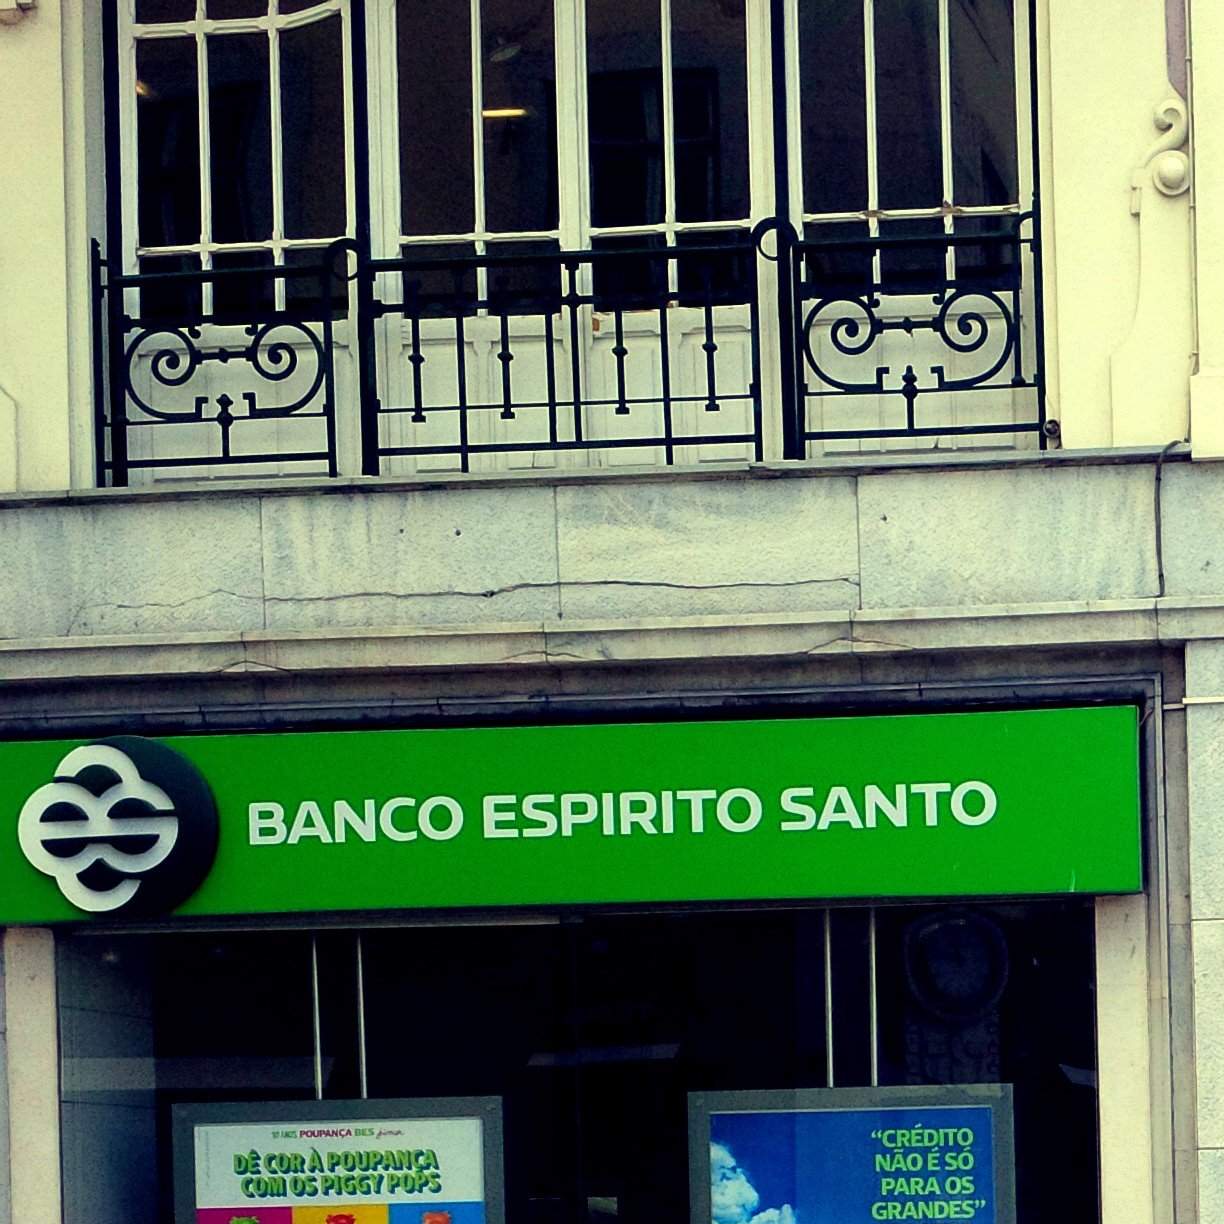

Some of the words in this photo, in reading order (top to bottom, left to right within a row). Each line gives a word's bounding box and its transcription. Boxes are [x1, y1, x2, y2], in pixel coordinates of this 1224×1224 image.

[248, 796, 464, 845] BANCO
[482, 788, 763, 838] ESPIRITO
[780, 780, 997, 831] SANTO
[300, 1128, 352, 1139] POUPANÇA
[871, 1123, 974, 1148] “CRÉDITO
[233, 1148, 261, 1175] DÊ
[263, 1153, 306, 1174] COR
[306, 1146, 325, 1173] À
[327, 1149, 440, 1173] POUPANÇA
[875, 1148, 923, 1172] NÃO
[927, 1147, 941, 1171] É
[944, 1146, 974, 1171] SÓ
[241, 1176, 287, 1198] COM
[289, 1175, 319, 1197] OS
[320, 1173, 384, 1196] PIGGY
[386, 1172, 442, 1194] POPS
[881, 1177, 941, 1196] PARA
[945, 1176, 975, 1195] OS
[871, 1199, 987, 1220] GRANDES”
